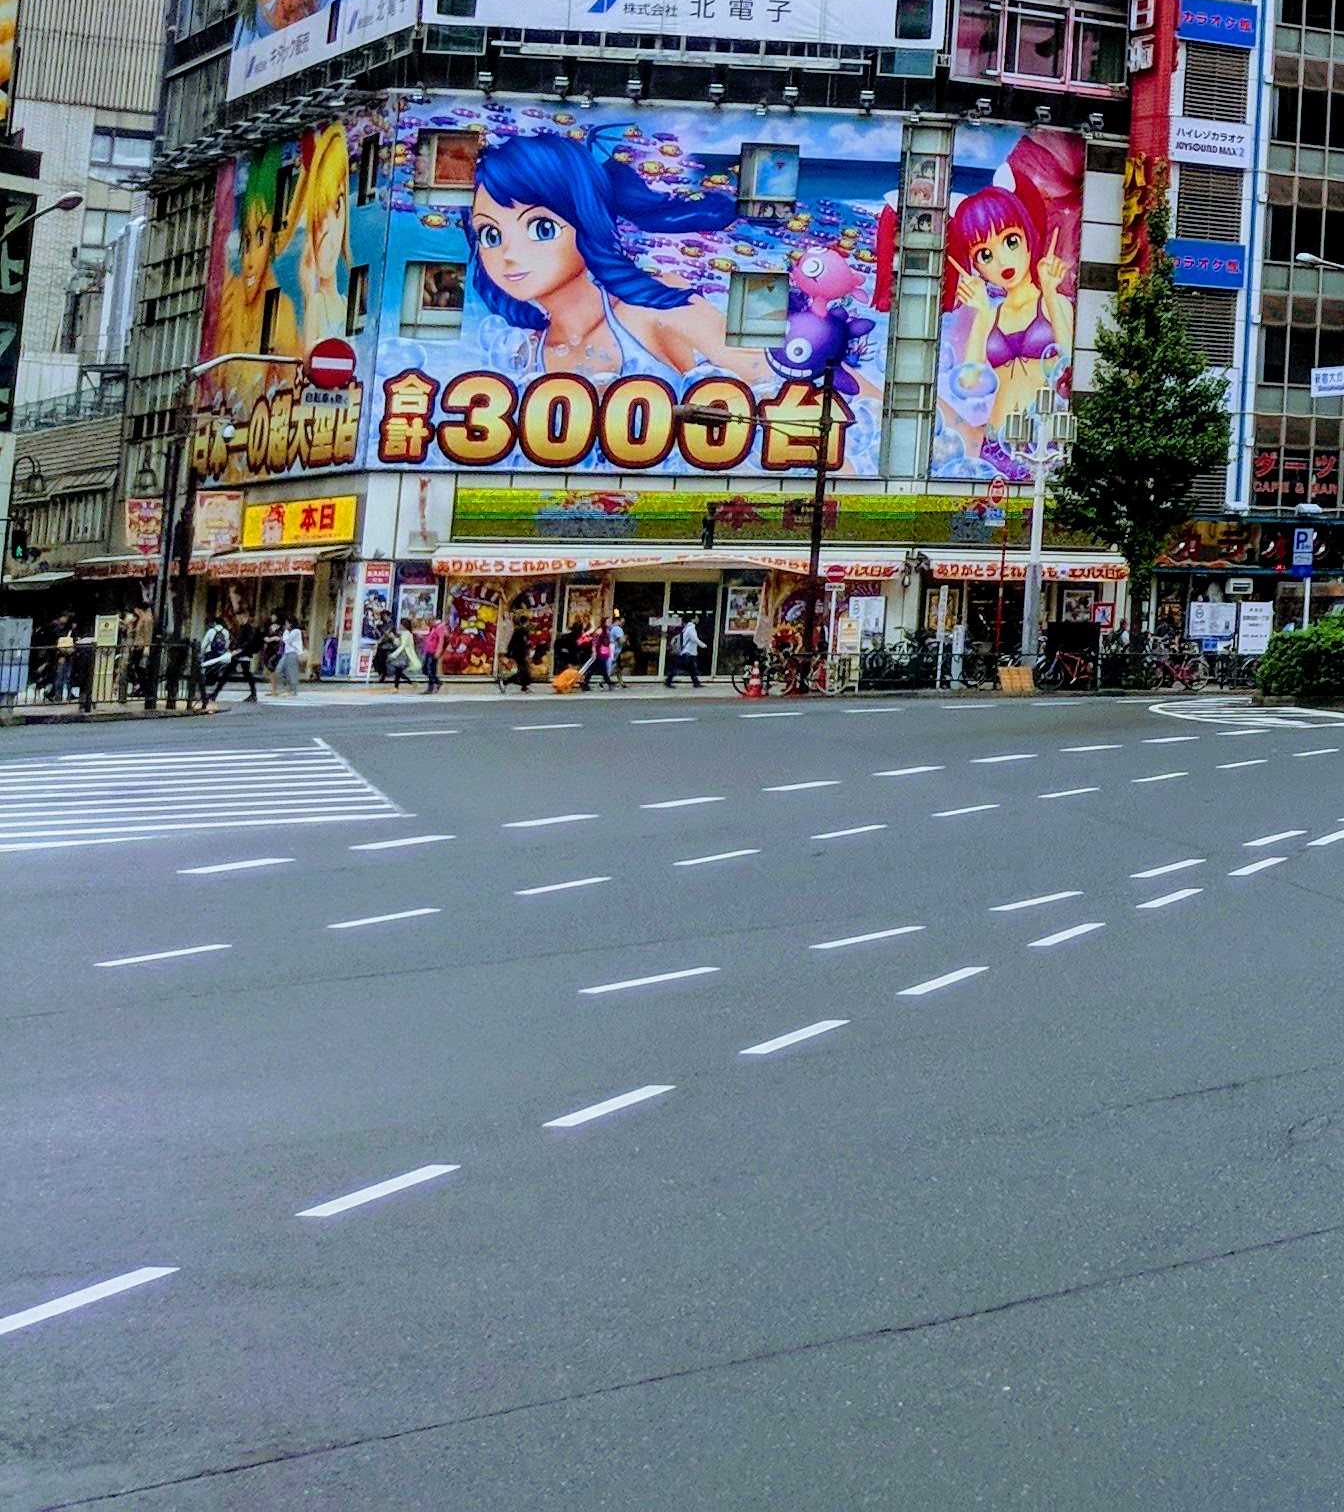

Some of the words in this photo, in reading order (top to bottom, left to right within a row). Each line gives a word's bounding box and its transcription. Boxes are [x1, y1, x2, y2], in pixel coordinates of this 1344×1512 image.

[623, 2, 678, 17] 株式会社
[379, 369, 440, 463] 合計
[438, 370, 854, 470] 3000台
[1255, 452, 1336, 478] ダーツ
[300, 504, 335, 532] 本日
